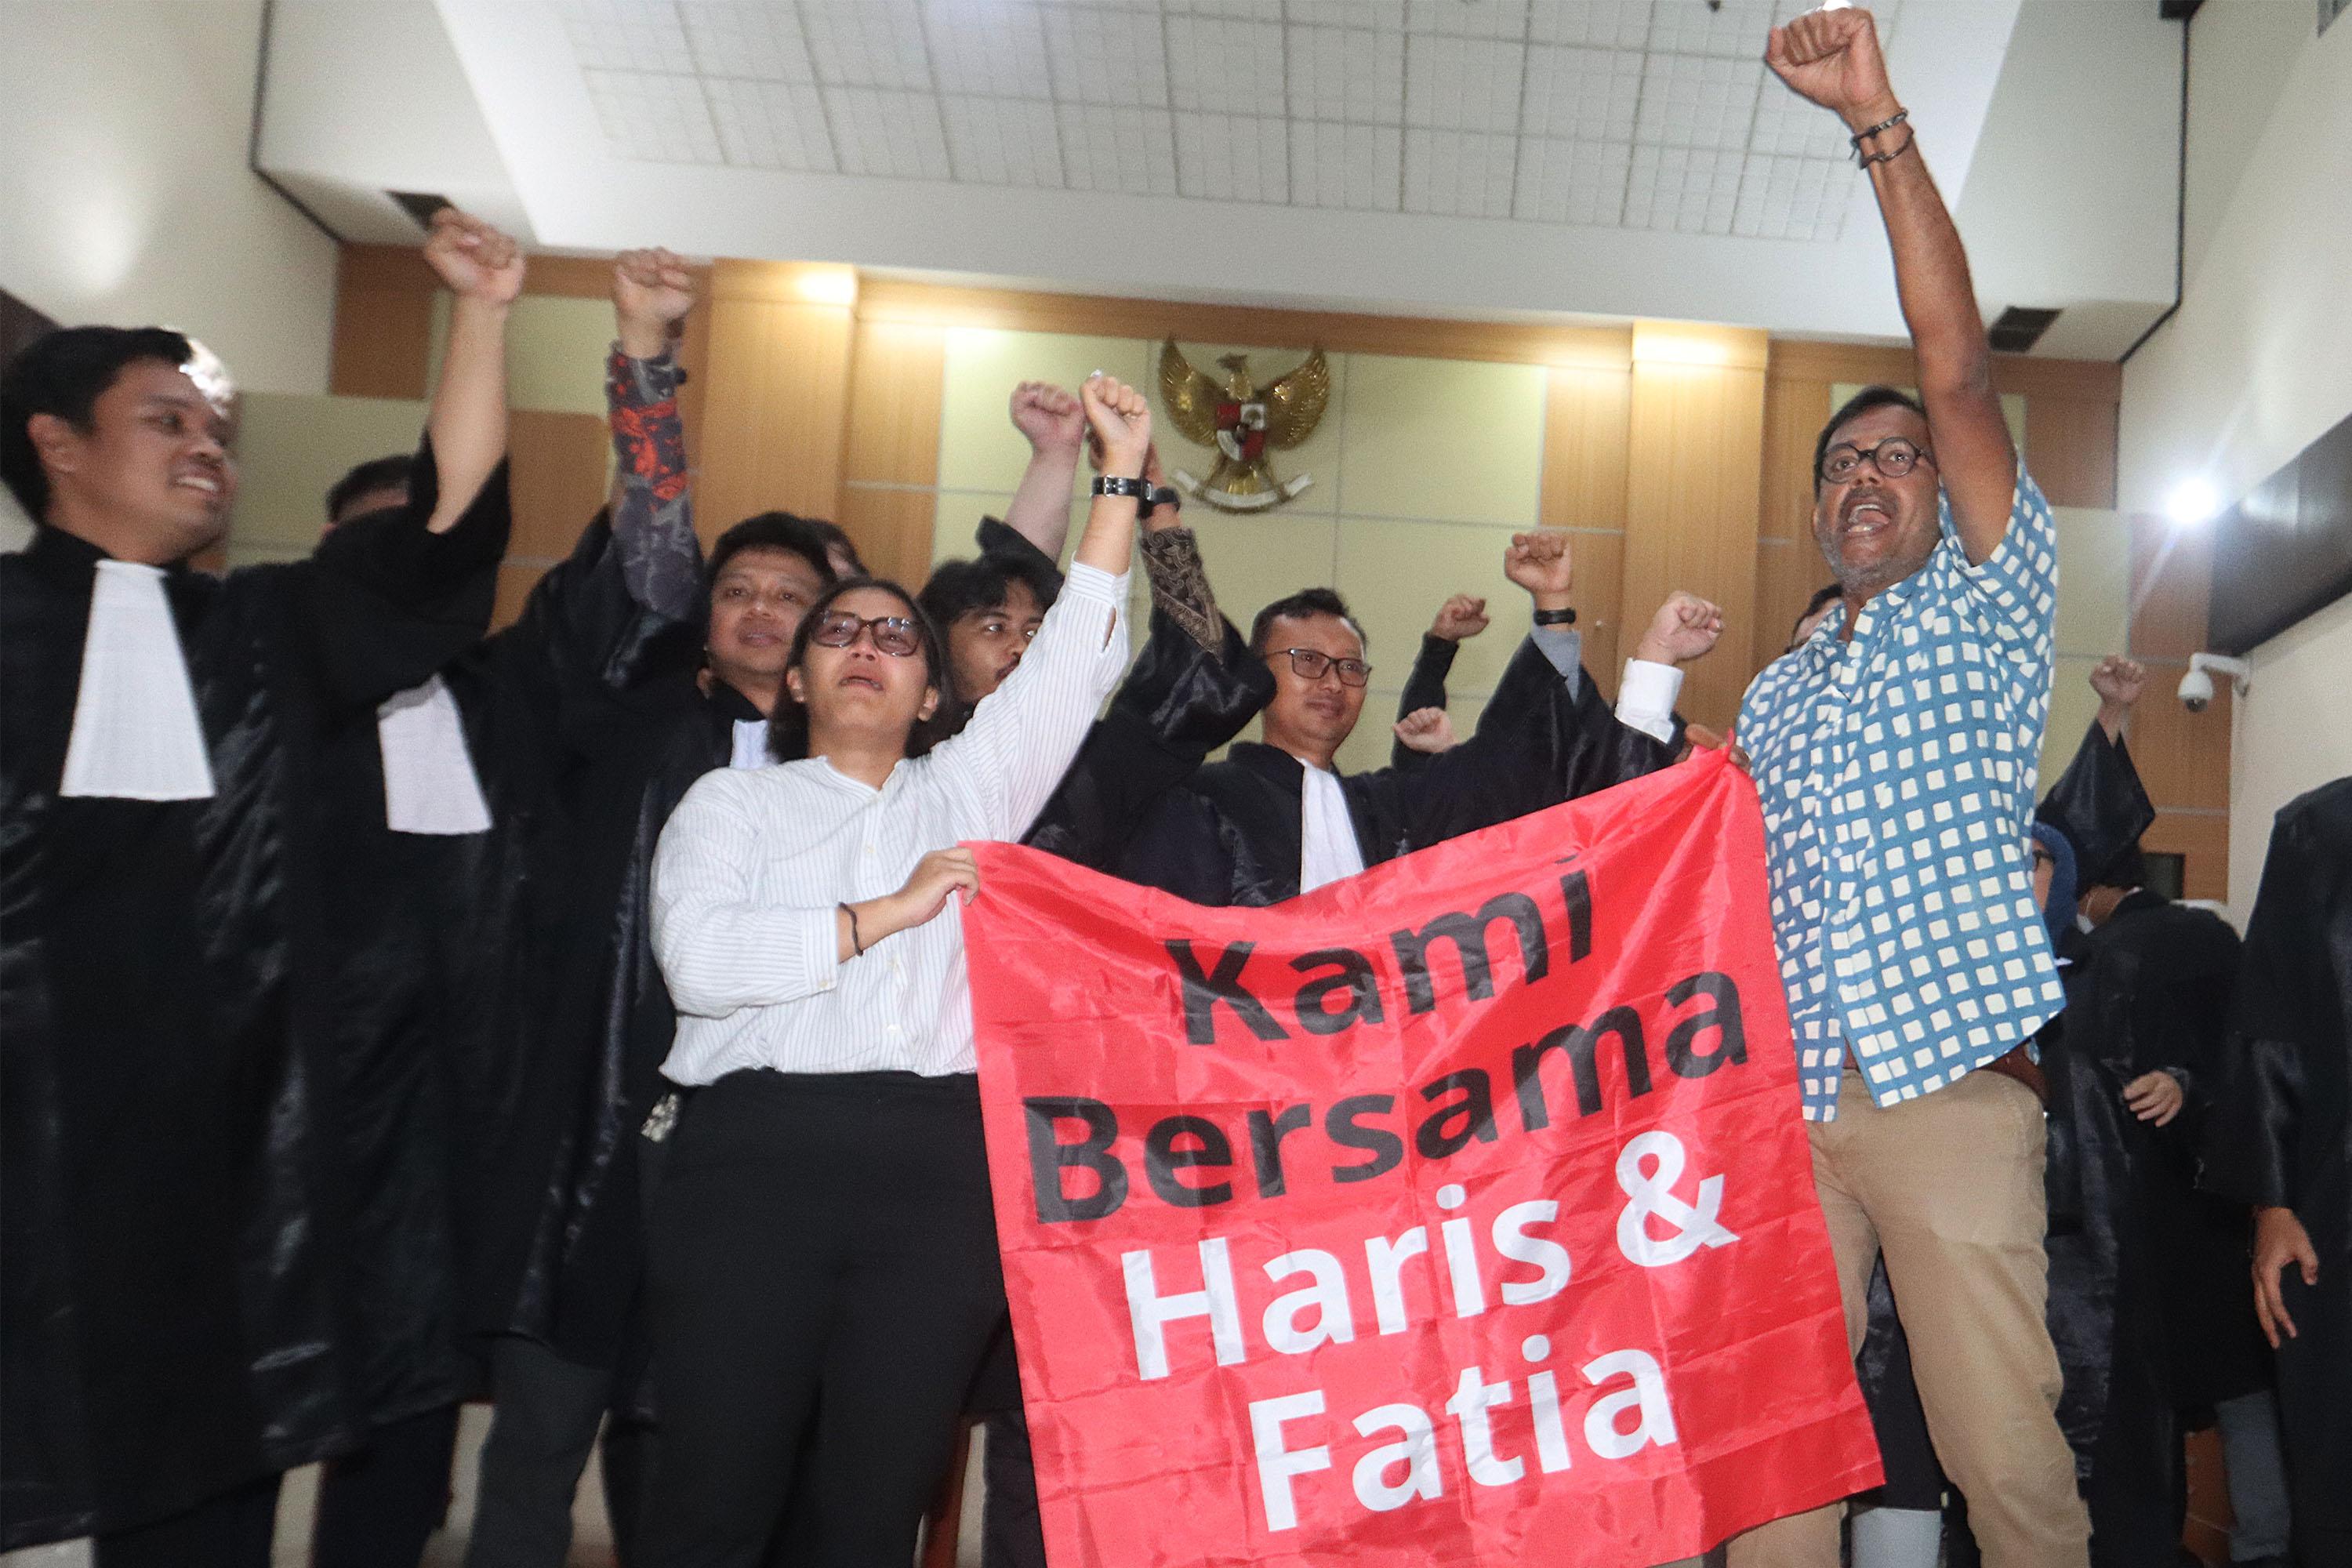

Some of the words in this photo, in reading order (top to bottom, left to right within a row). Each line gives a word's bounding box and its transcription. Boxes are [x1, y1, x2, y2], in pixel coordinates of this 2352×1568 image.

[1163, 855, 1593, 1046] Kami
[1022, 971, 1749, 1224] Bersama
[1121, 1184, 1572, 1381] Haris
[1615, 1130, 1740, 1269] &
[1249, 1336, 1678, 1533] Fatia
